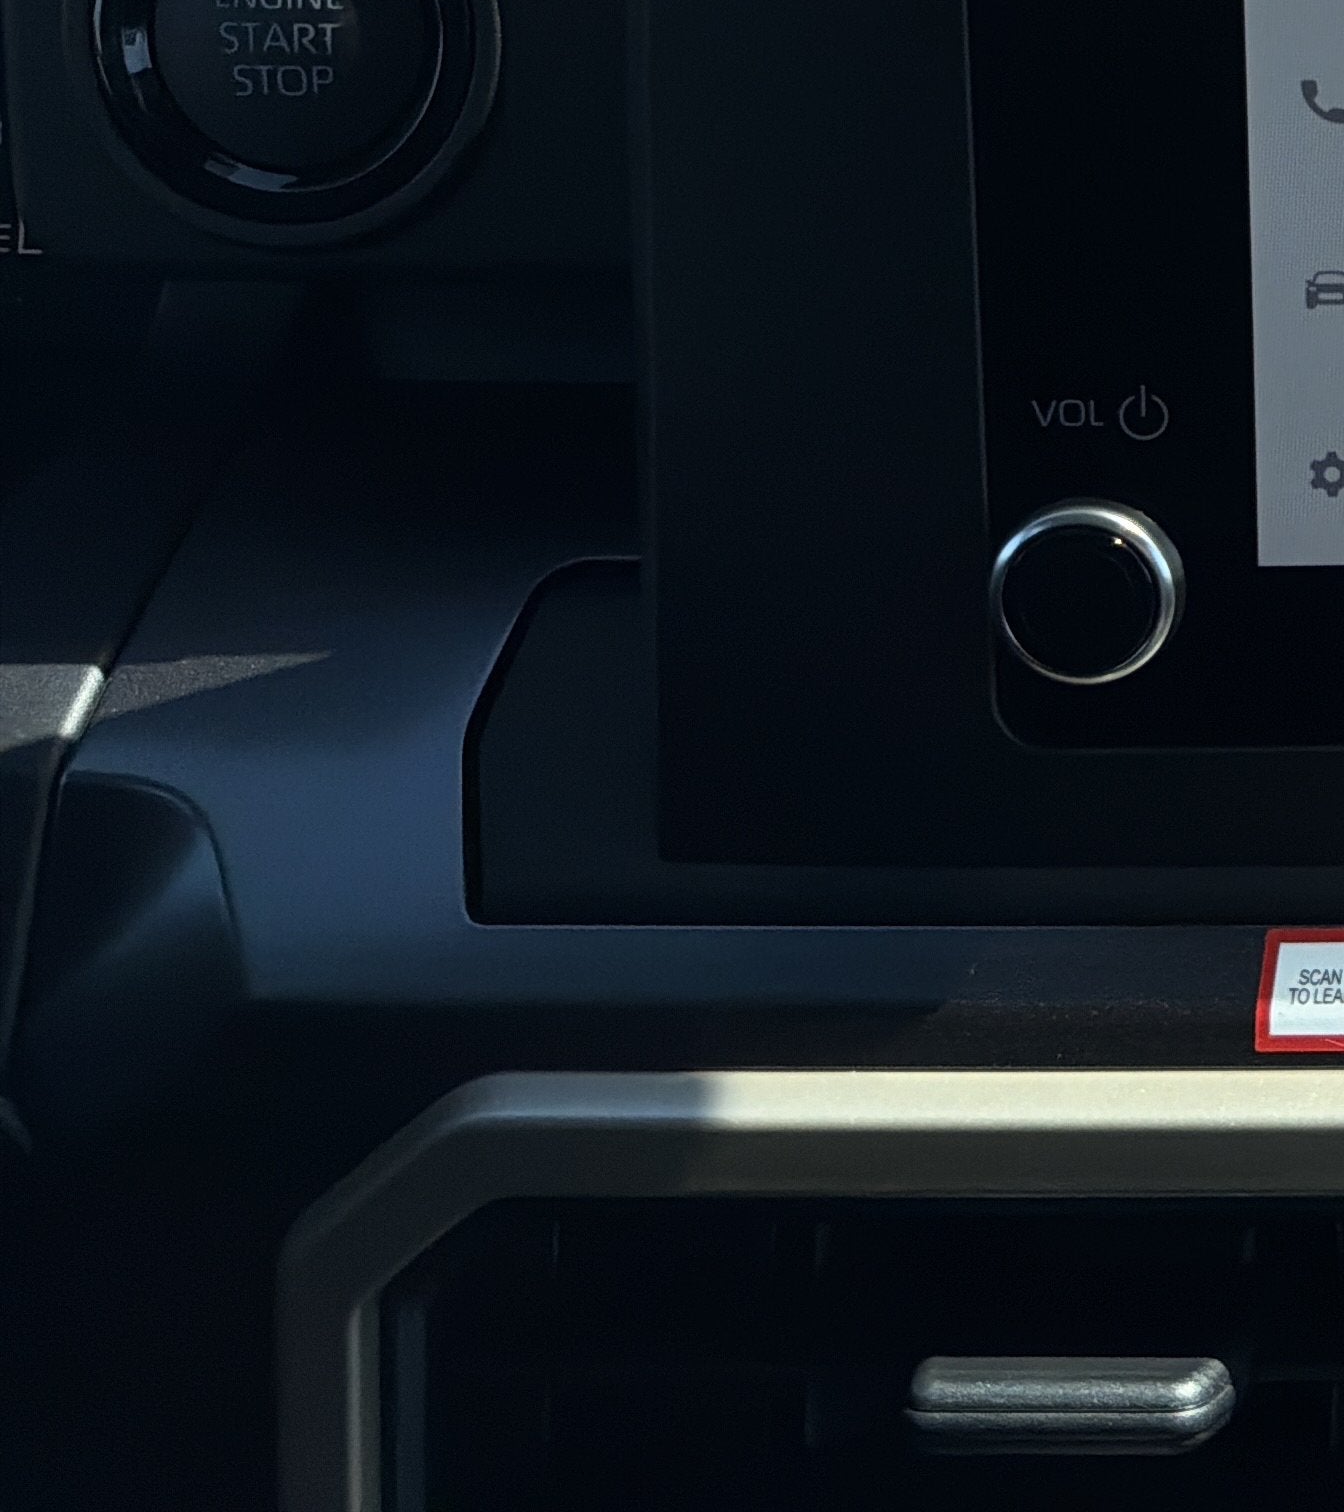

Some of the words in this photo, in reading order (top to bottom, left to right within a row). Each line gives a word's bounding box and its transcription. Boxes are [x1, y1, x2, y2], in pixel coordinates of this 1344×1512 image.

[219, 21, 343, 54] START
[232, 63, 334, 97] STOP
[1031, 399, 1104, 427] VOL
[1298, 968, 1338, 986] SCAN
[1288, 986, 1311, 1005] TO
